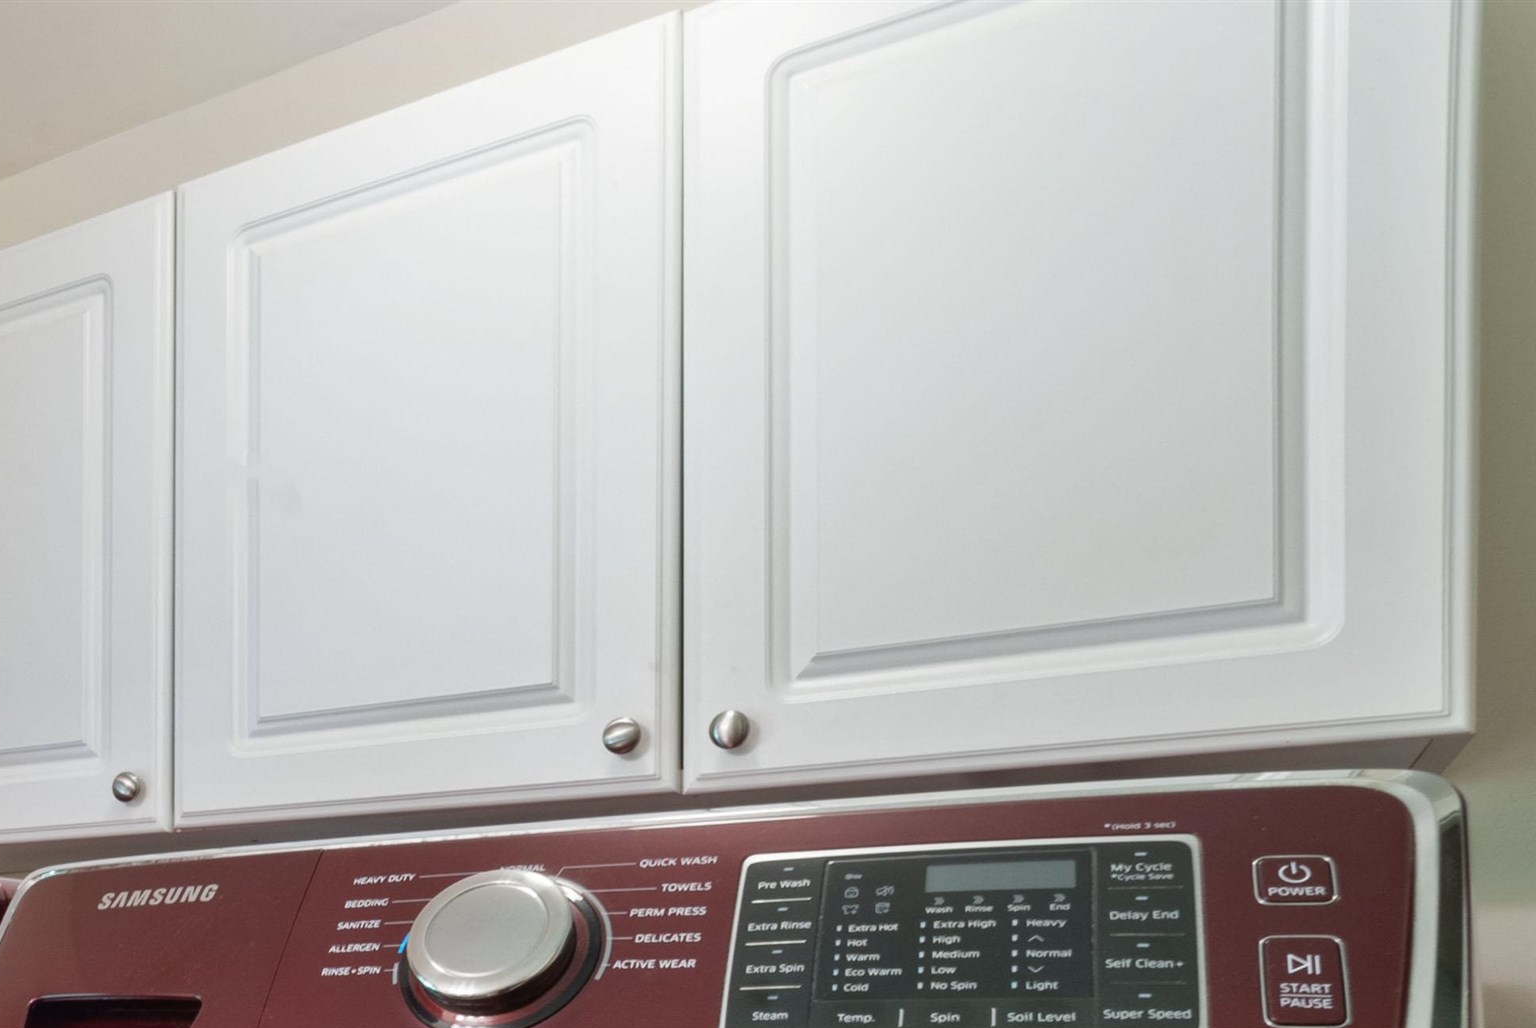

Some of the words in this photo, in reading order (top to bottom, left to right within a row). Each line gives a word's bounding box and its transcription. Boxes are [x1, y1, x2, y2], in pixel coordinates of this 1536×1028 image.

[1143, 821, 1151, 829] 3
[639, 858, 677, 868] QUICK
[680, 856, 718, 866] WASH
[1110, 863, 1132, 873] My
[1135, 862, 1173, 872] Cycle
[353, 875, 387, 886] HEAVY
[388, 873, 416, 883] DUTY
[1147, 873, 1175, 881] Save
[661, 881, 713, 892] TOWELS
[757, 881, 777, 890] Pre
[779, 879, 811, 888] Wash
[1267, 886, 1327, 897] POWER
[97, 884, 219, 910] SAMSUNG
[344, 898, 389, 909] BEDDING
[1007, 904, 1031, 912] Spin
[1049, 903, 1071, 911] End
[629, 908, 665, 917] PERM
[667, 906, 707, 916] PRESS
[925, 906, 953, 914] Wash
[965, 905, 994, 913] Rinse
[1109, 911, 1149, 922] Delay
[1152, 910, 1180, 920] End
[336, 919, 382, 930] SANITIZE
[747, 922, 778, 932] Extra
[780, 920, 812, 930] Rinse
[848, 924, 877, 932] Extra
[878, 923, 899, 932] Hot
[933, 921, 965, 929] Extra
[967, 920, 997, 929] High
[1026, 919, 1067, 928] Heavy
[634, 933, 702, 943] DELICATES
[846, 939, 868, 947] Hot
[932, 935, 961, 945] High
[328, 942, 381, 953] ALLERGEN
[846, 953, 881, 961] Warm
[931, 950, 980, 958] Medium
[1025, 949, 1072, 957] Normal
[612, 959, 656, 969] ACTIVE
[659, 959, 697, 969] WEAR
[745, 965, 776, 974] Extra
[779, 963, 805, 973] Spin
[1104, 959, 1132, 969] Self
[844, 968, 865, 976] Eco
[867, 967, 902, 976] Warm
[931, 966, 957, 974] Low
[843, 983, 869, 992] Cold
[930, 982, 948, 990] No
[950, 981, 978, 991] Spin
[1025, 980, 1059, 991] Light
[1279, 982, 1333, 994] START
[1279, 997, 1334, 1009] PAUSE
[751, 1011, 789, 1021] Steam
[837, 1012, 876, 1023] Temp.
[930, 1012, 961, 1023] Spin
[1007, 1012, 1034, 1022] Soil
[1037, 1012, 1076, 1022] Level
[1102, 1009, 1144, 1021] Super
[1147, 1008, 1193, 1021] Speed
